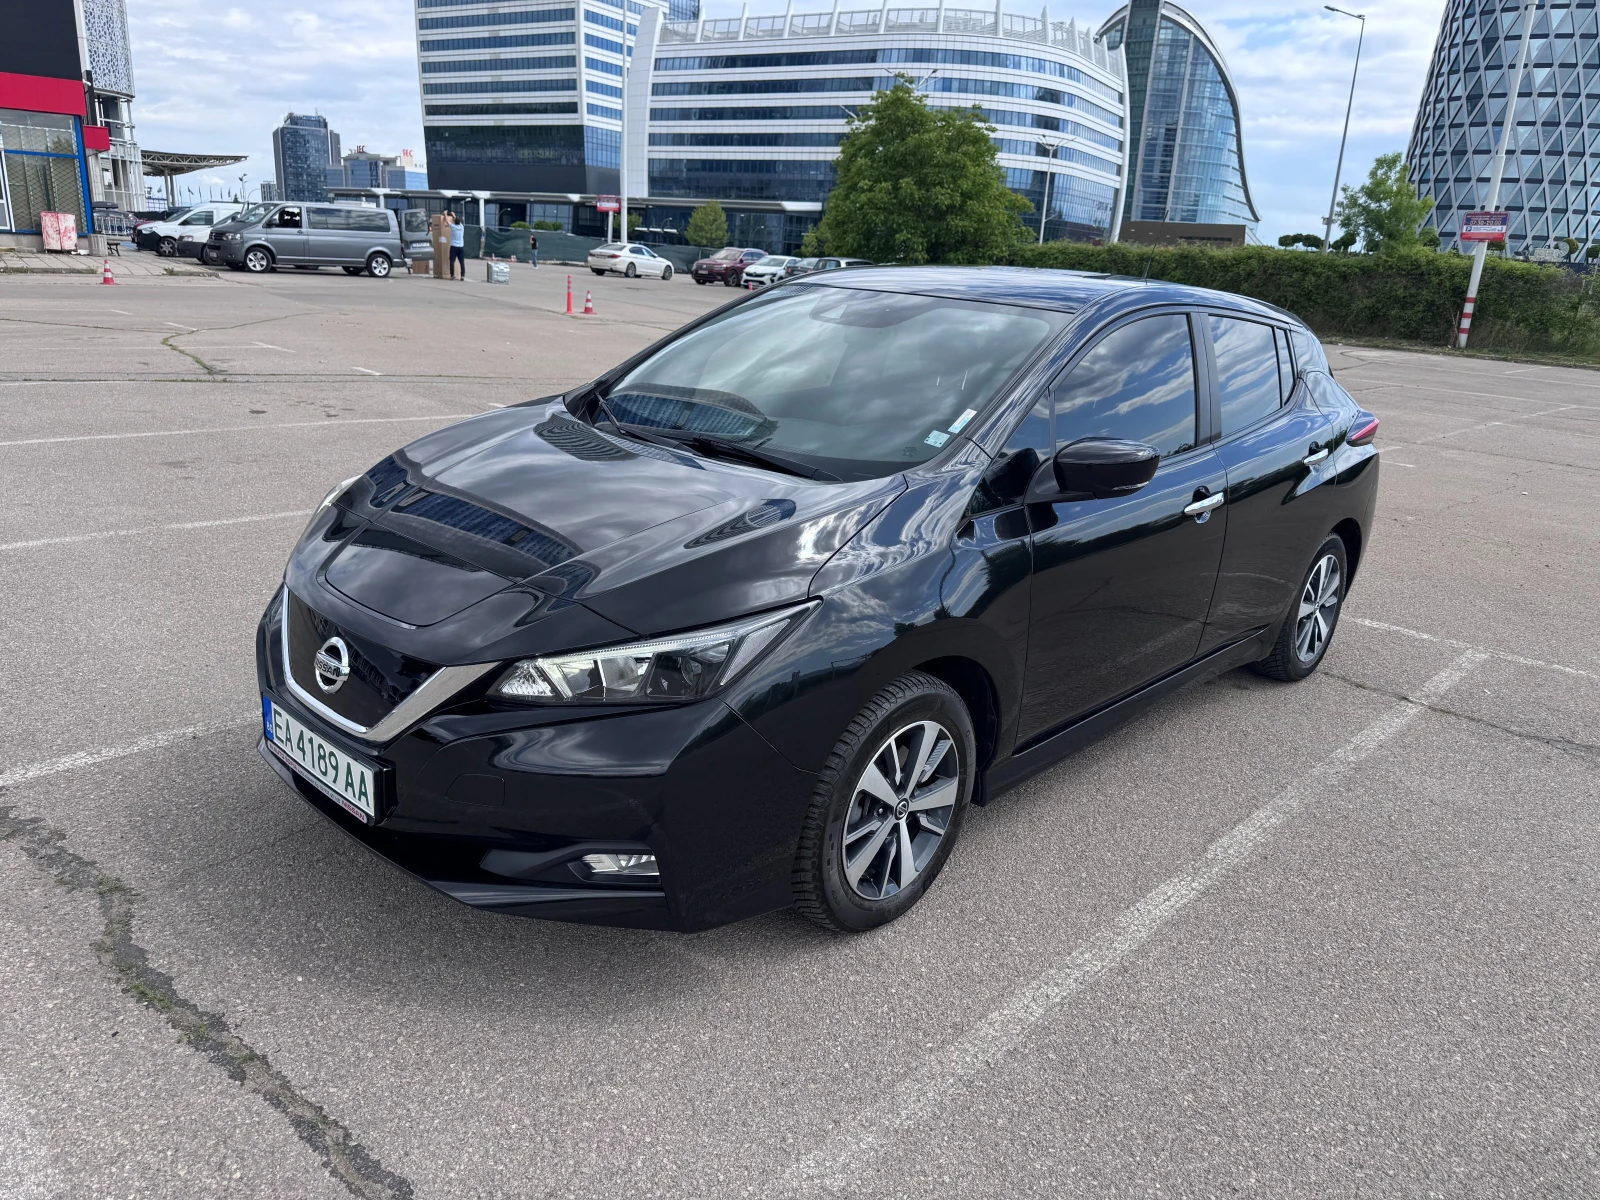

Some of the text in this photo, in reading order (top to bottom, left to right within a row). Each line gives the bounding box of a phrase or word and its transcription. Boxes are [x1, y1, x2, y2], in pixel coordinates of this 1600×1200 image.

[274, 708, 293, 752] EA
[297, 729, 340, 784] 4189
[345, 761, 370, 808] AA
